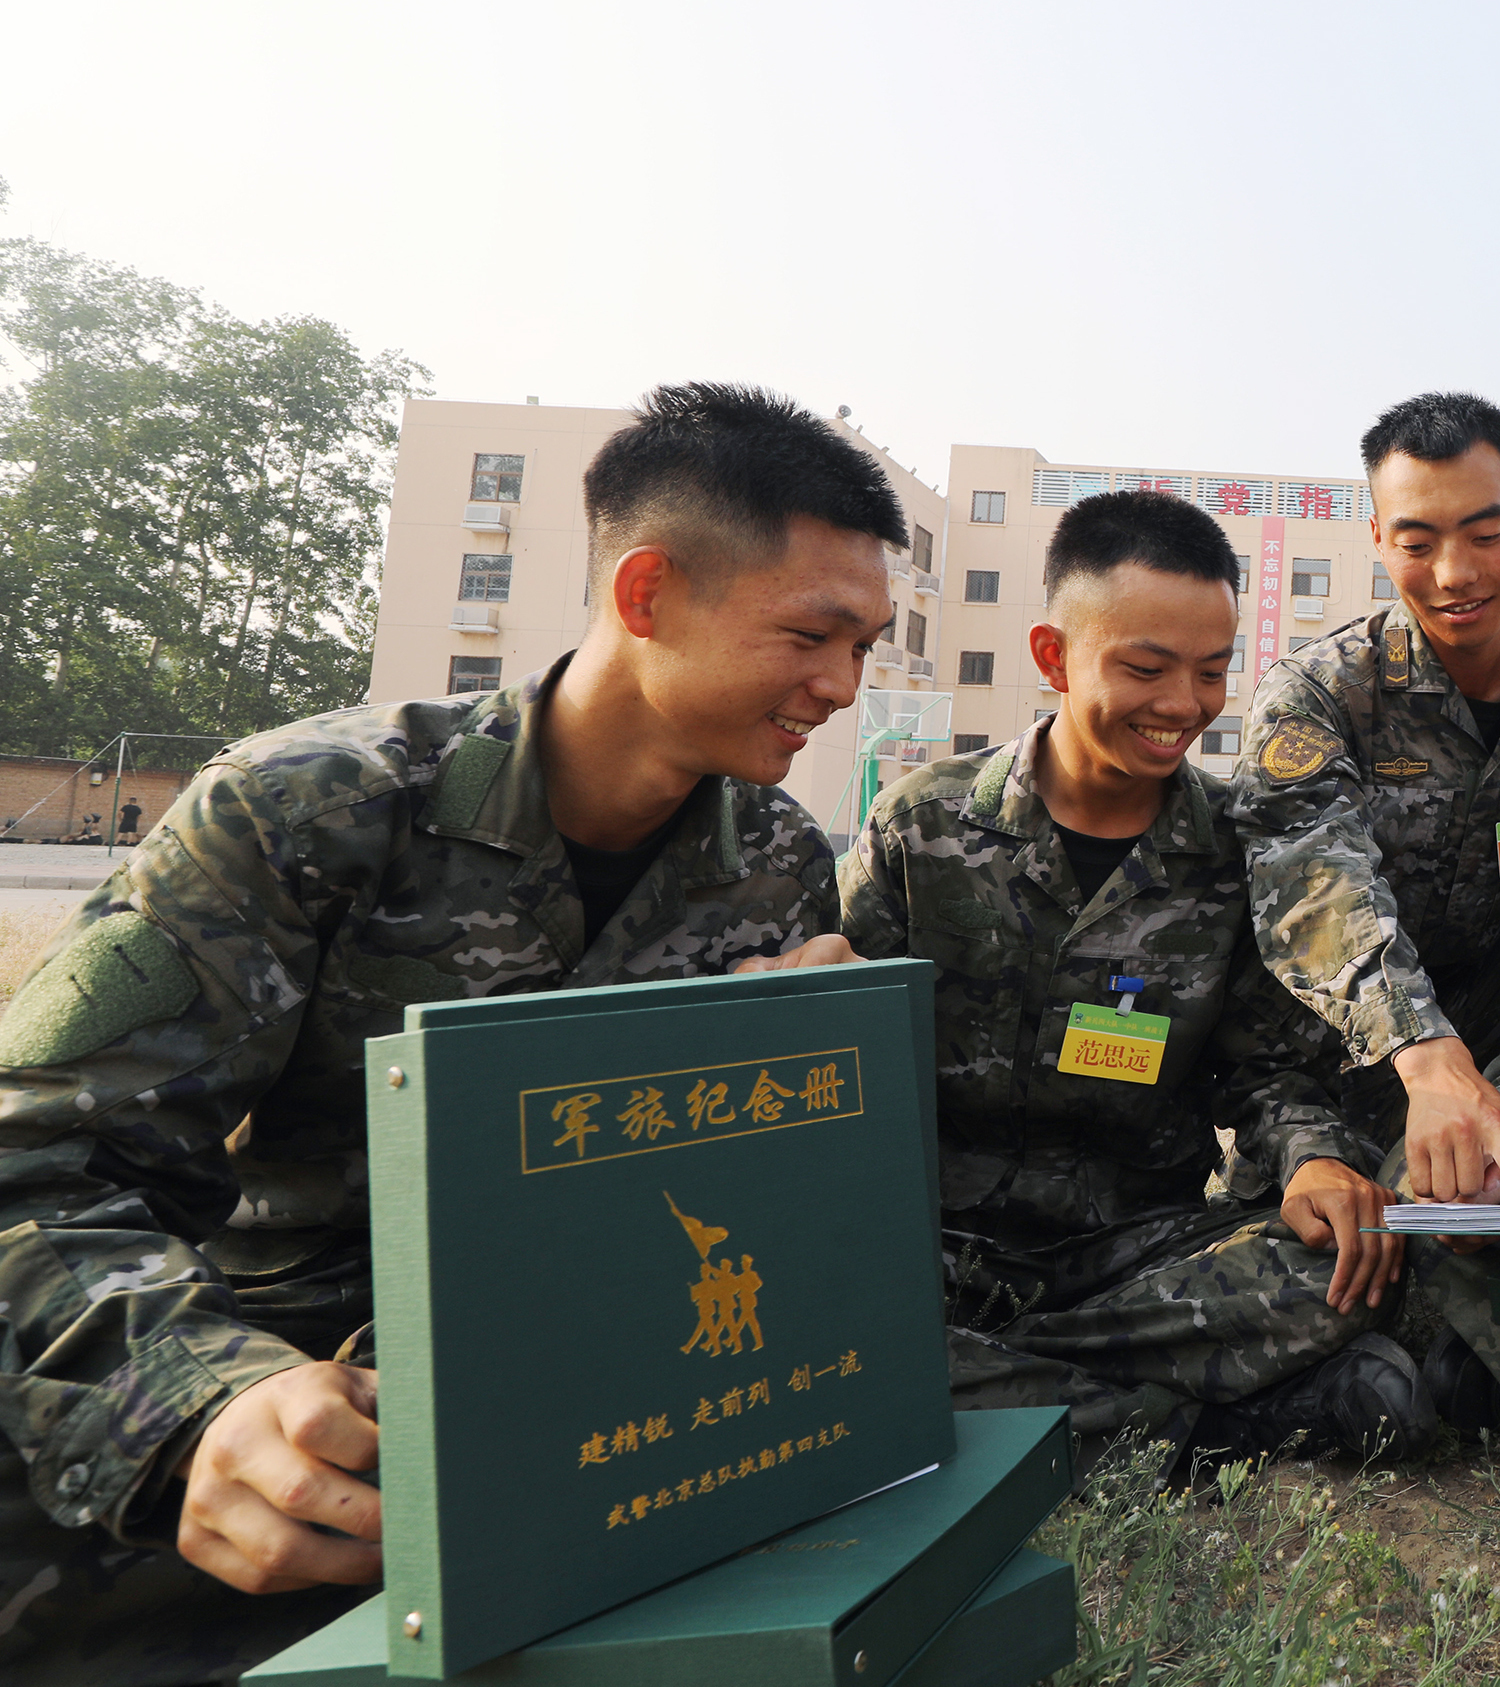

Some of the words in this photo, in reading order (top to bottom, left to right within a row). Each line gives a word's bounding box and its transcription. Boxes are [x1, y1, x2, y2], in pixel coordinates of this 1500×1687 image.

[1262, 540, 1280, 610] 不忘初心
[1258, 618, 1276, 678] 自信自
[1075, 1039, 1150, 1073] 范思远
[550, 1063, 844, 1157] 军旅纪念册
[579, 1413, 673, 1469] 建精锐
[690, 1378, 770, 1431] 走前列
[787, 1350, 862, 1391] 创一流
[607, 1422, 850, 1530] 武警北京总队执勤第四支队
